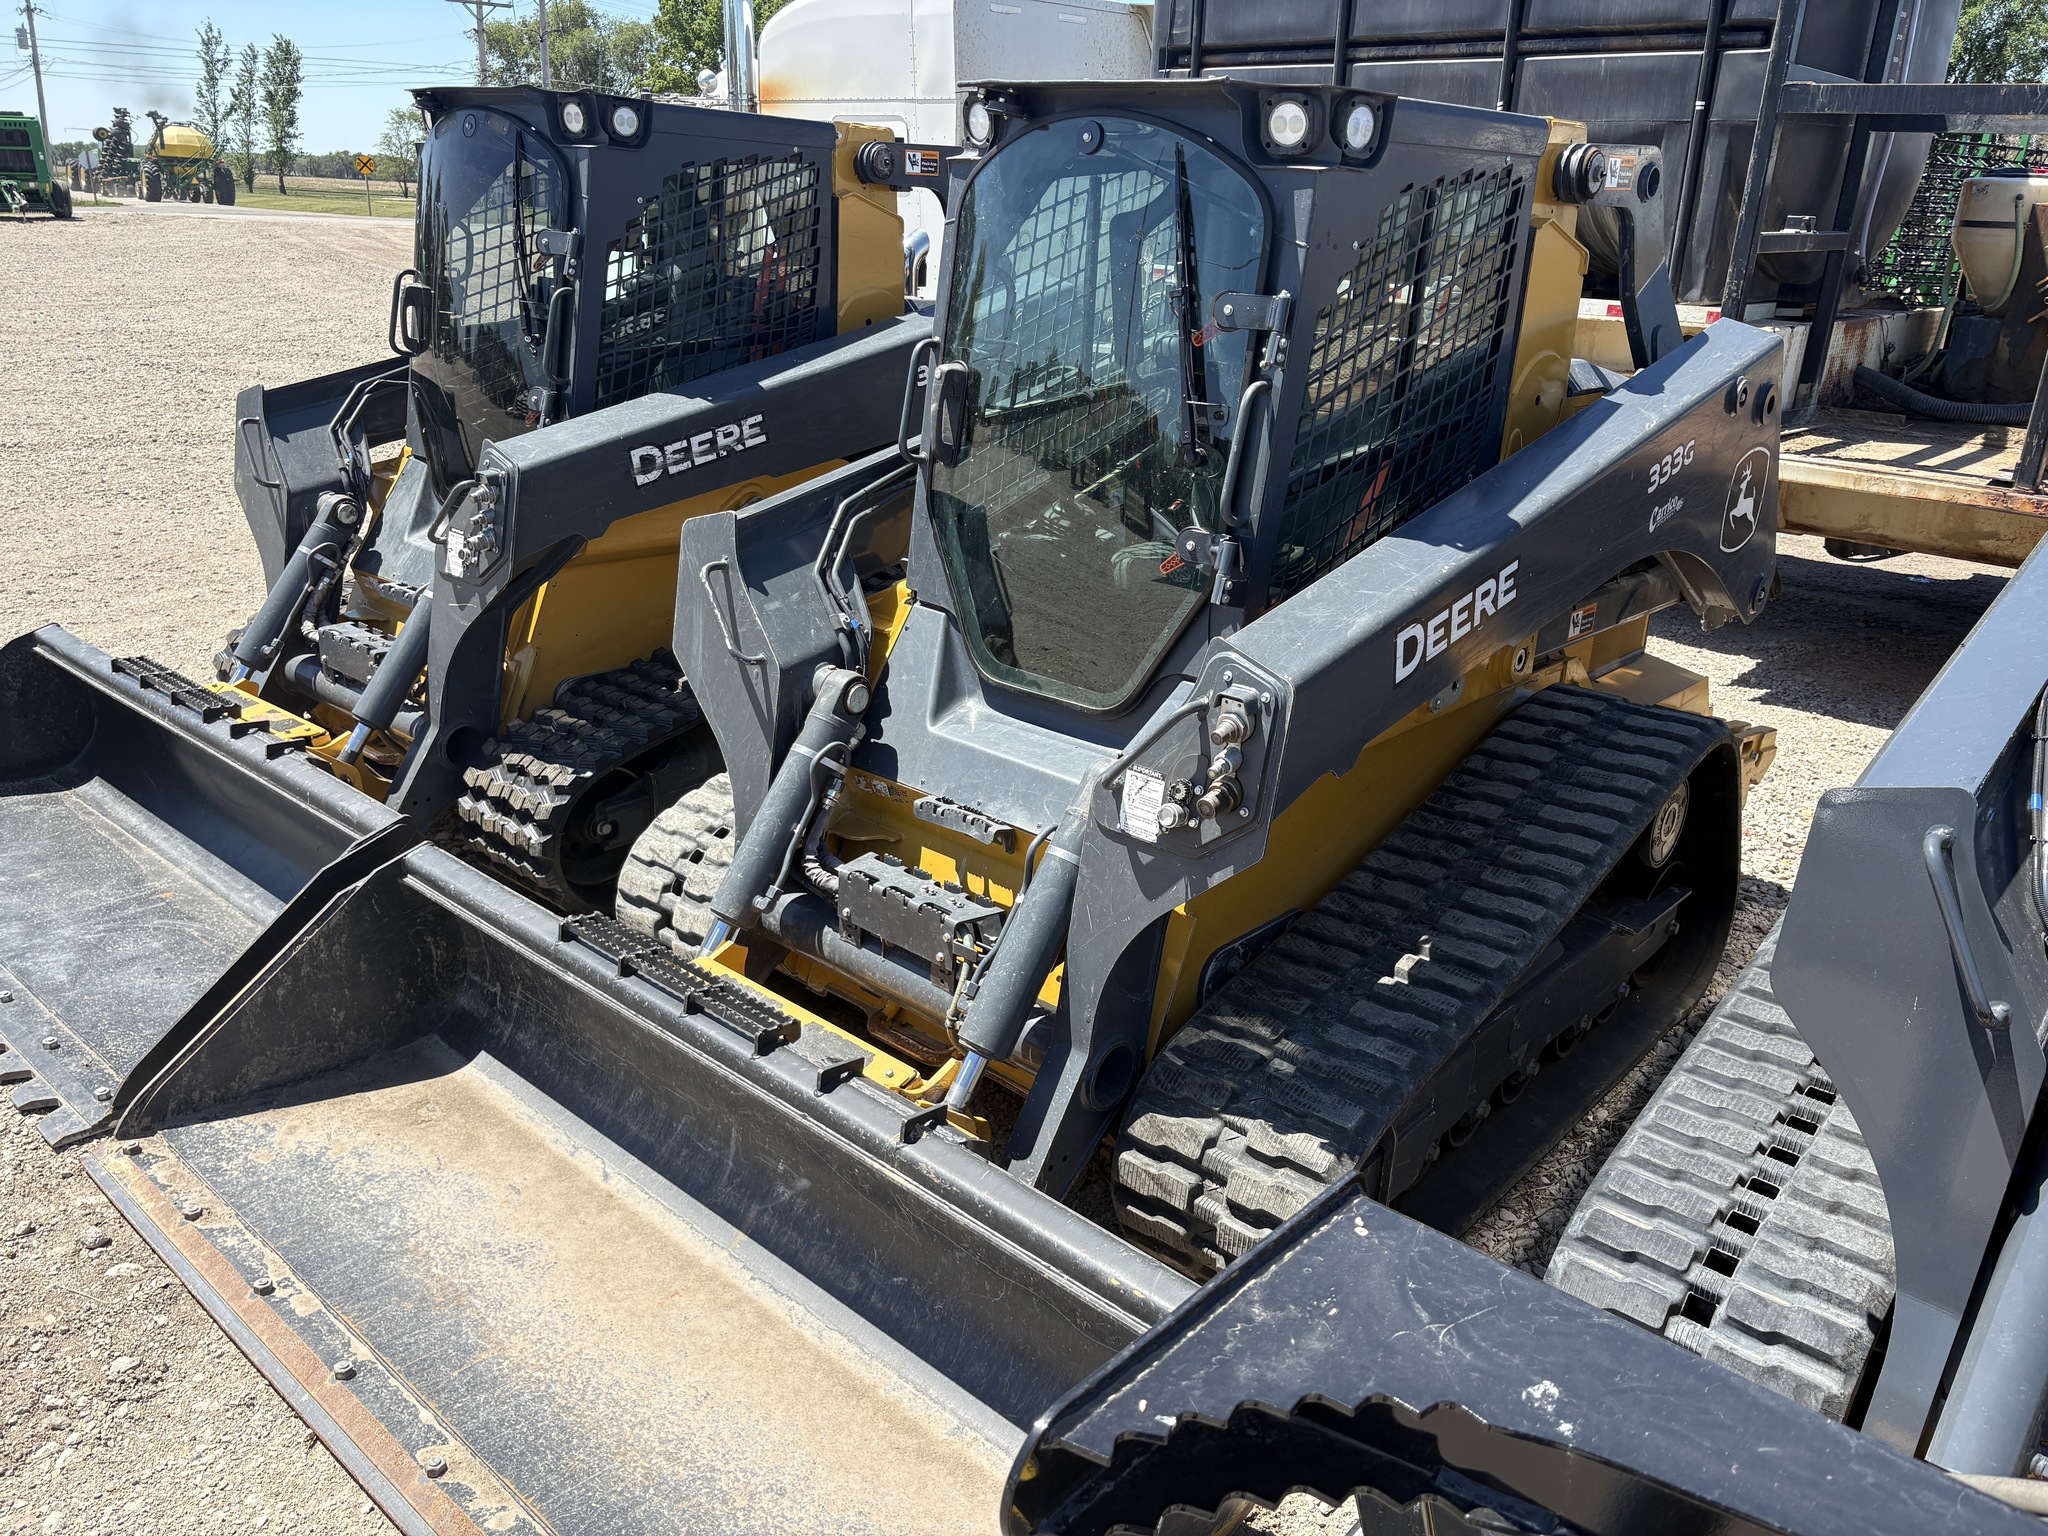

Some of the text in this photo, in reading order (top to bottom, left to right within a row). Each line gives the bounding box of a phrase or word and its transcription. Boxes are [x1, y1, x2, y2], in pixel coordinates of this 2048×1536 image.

[630, 413, 767, 486] DEERE
[1647, 439, 1696, 494] 333G
[1395, 559, 1519, 684] DEERE
